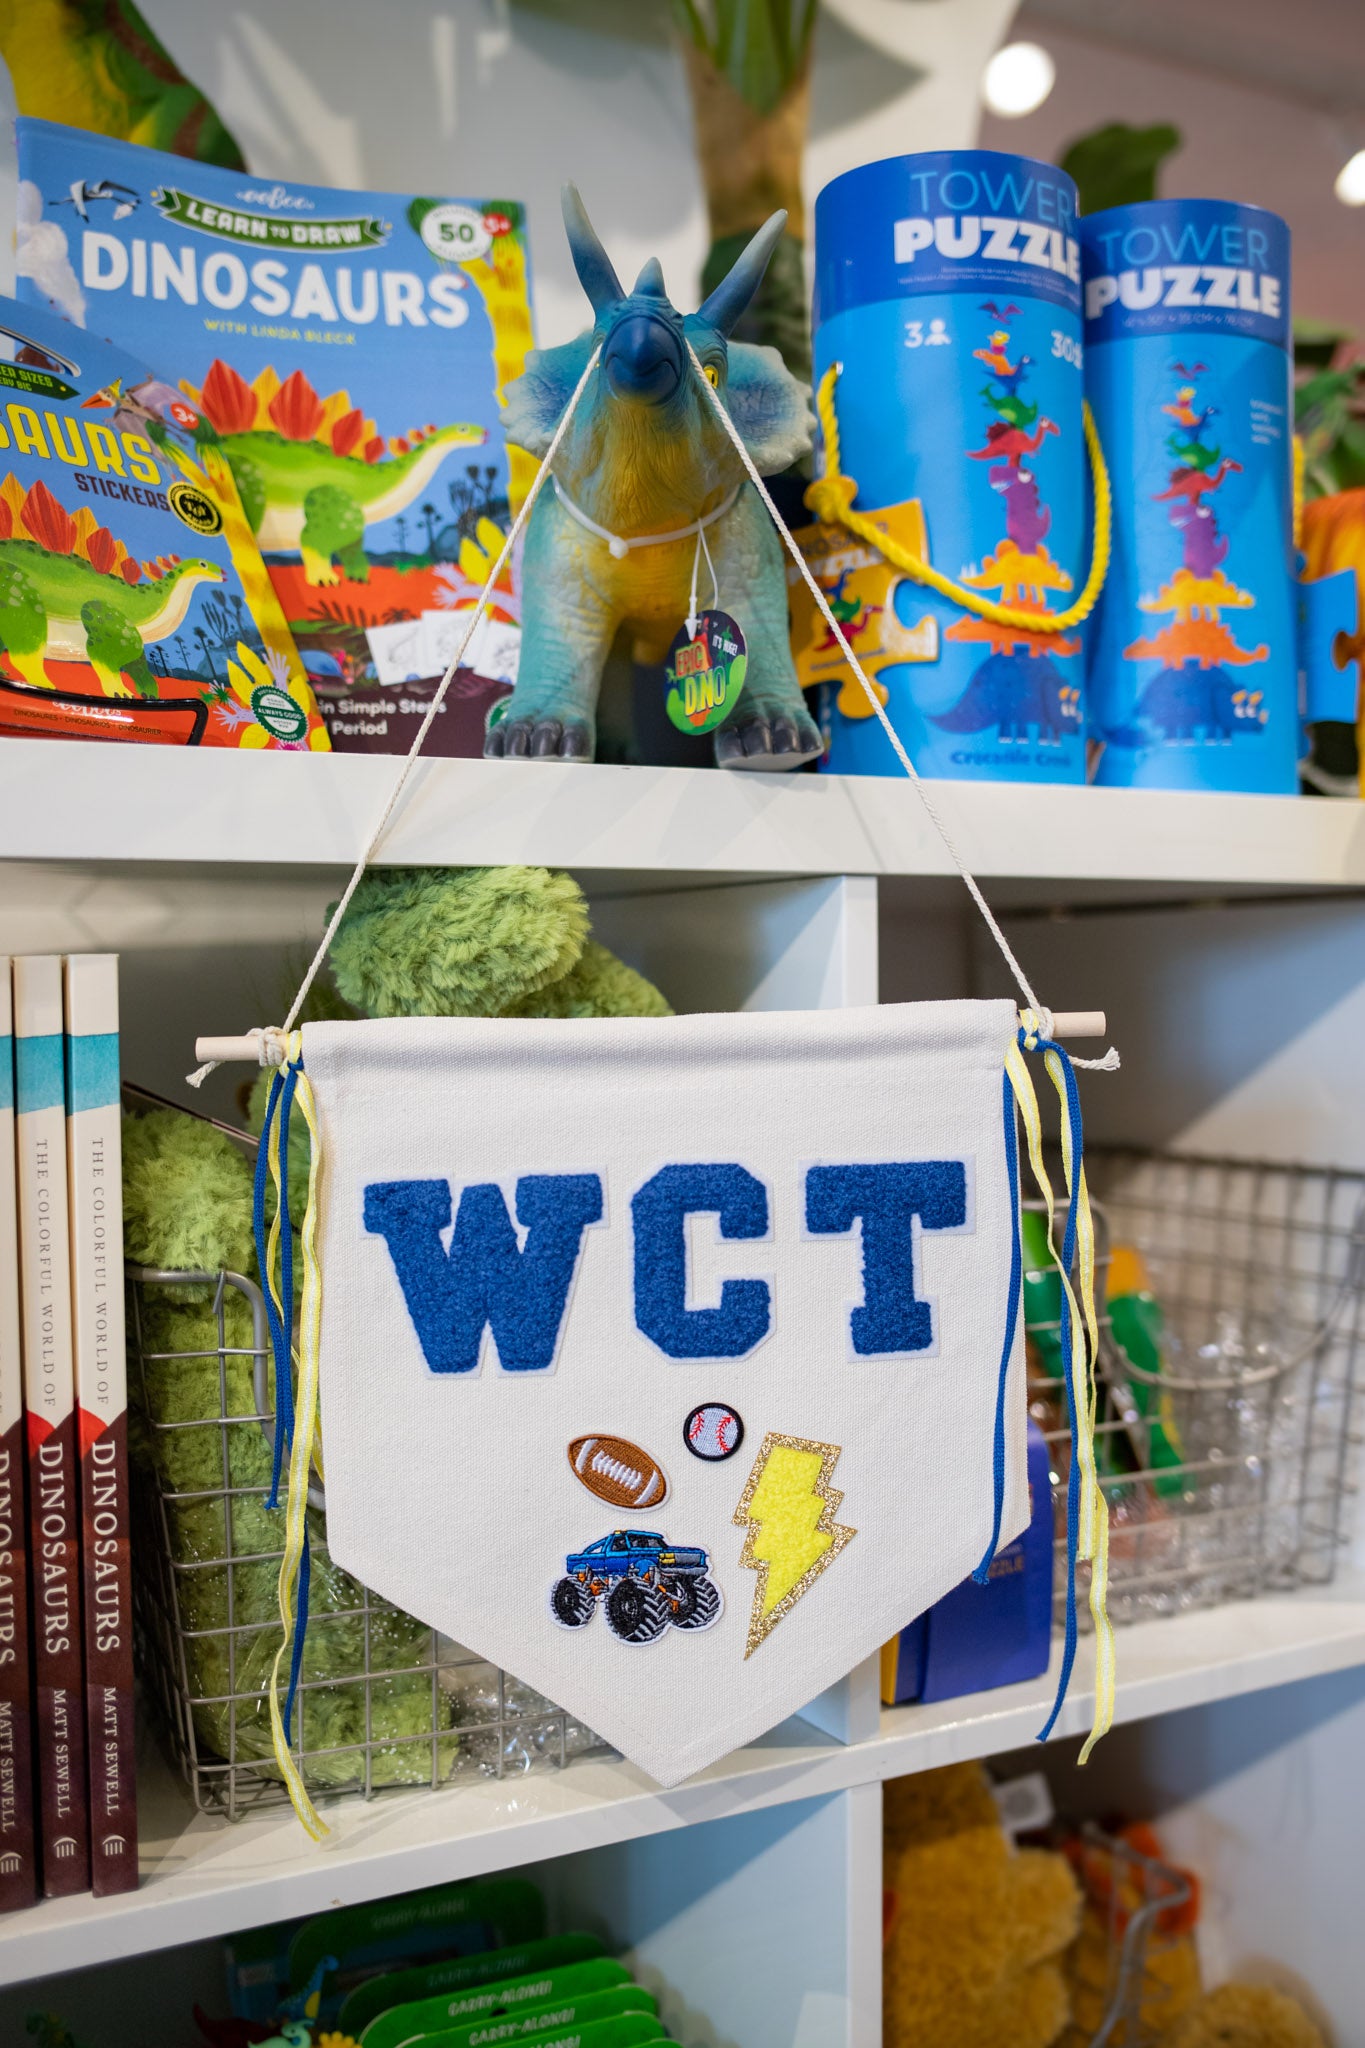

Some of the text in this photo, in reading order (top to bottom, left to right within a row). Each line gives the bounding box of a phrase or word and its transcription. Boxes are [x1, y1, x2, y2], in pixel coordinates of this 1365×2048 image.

[185, 201, 268, 239] LEARN
[291, 224, 362, 245] DRAW
[910, 170, 1074, 233] TOWER
[439, 223, 474, 243] 50
[894, 215, 1081, 285] PUZZLE
[1096, 223, 1270, 271] TOWER
[83, 229, 470, 329] DINOSAURS
[1085, 265, 1281, 320] PUZZLE
[204, 317, 247, 335] WITH
[904, 320, 924, 348] 3
[18, 369, 54, 388] SIZES
[74, 472, 171, 513] STICKERS
[338, 698, 397, 718] Simple
[685, 665, 727, 718] DINO
[332, 719, 389, 736] Period
[37, 1139, 56, 1406] THE COLORFUL WORLD OF
[92, 1137, 109, 1404] THE COLORFUL WORLD OF
[363, 1160, 967, 1373] WCT
[40, 1442, 70, 1655] DINOSAURS
[92, 1440, 121, 1654] DINOSAURS
[0, 1701, 16, 1833] MATT SEWELL
[53, 1688, 71, 1818] MATT SEWELL
[104, 1687, 120, 1816] MATT SEWELL
